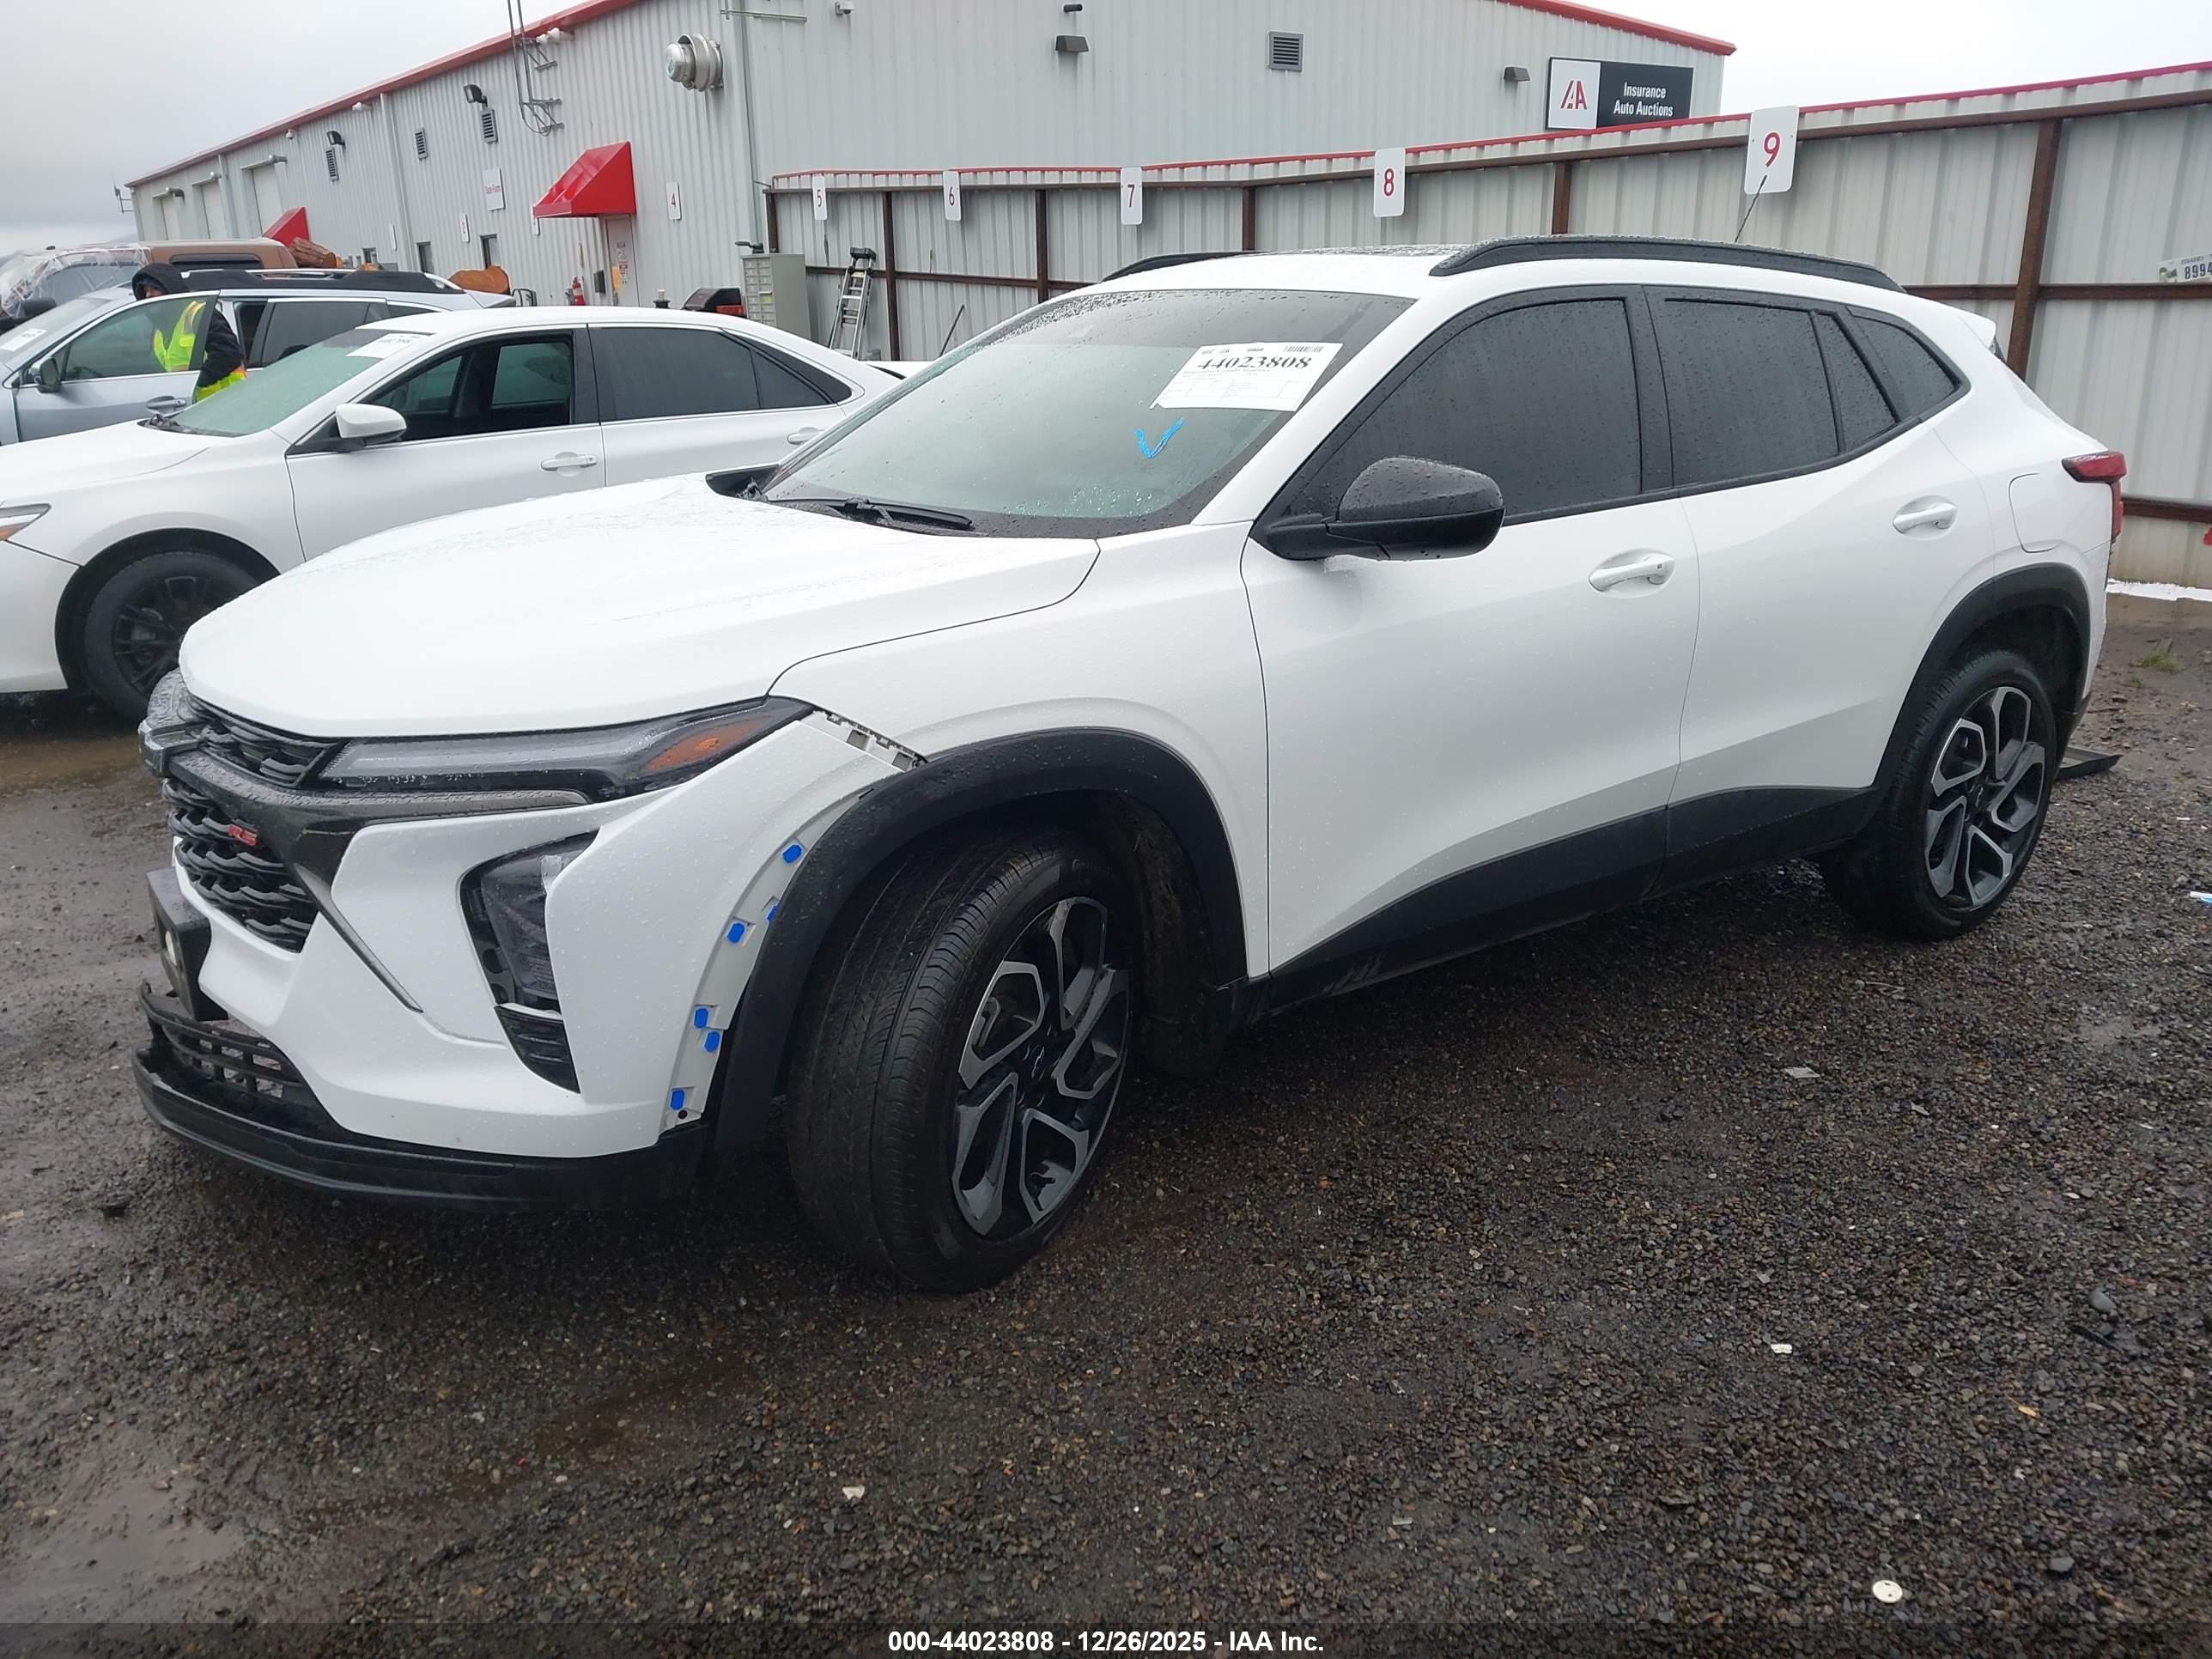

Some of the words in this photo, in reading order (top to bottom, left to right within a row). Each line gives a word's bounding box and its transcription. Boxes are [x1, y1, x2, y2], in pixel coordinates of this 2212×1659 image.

[1623, 82, 1667, 99] Insurance
[1613, 99, 1634, 115] Auto
[1635, 100, 1674, 117] Auctions
[1764, 131, 1781, 167] 9
[1383, 167, 1395, 197] 8
[671, 192, 677, 208] 4
[817, 188, 823, 208] 5
[948, 185, 955, 207] 6
[1127, 184, 1135, 208] 7
[1197, 356, 1312, 370] 44023808
[228, 823, 257, 847] RS
